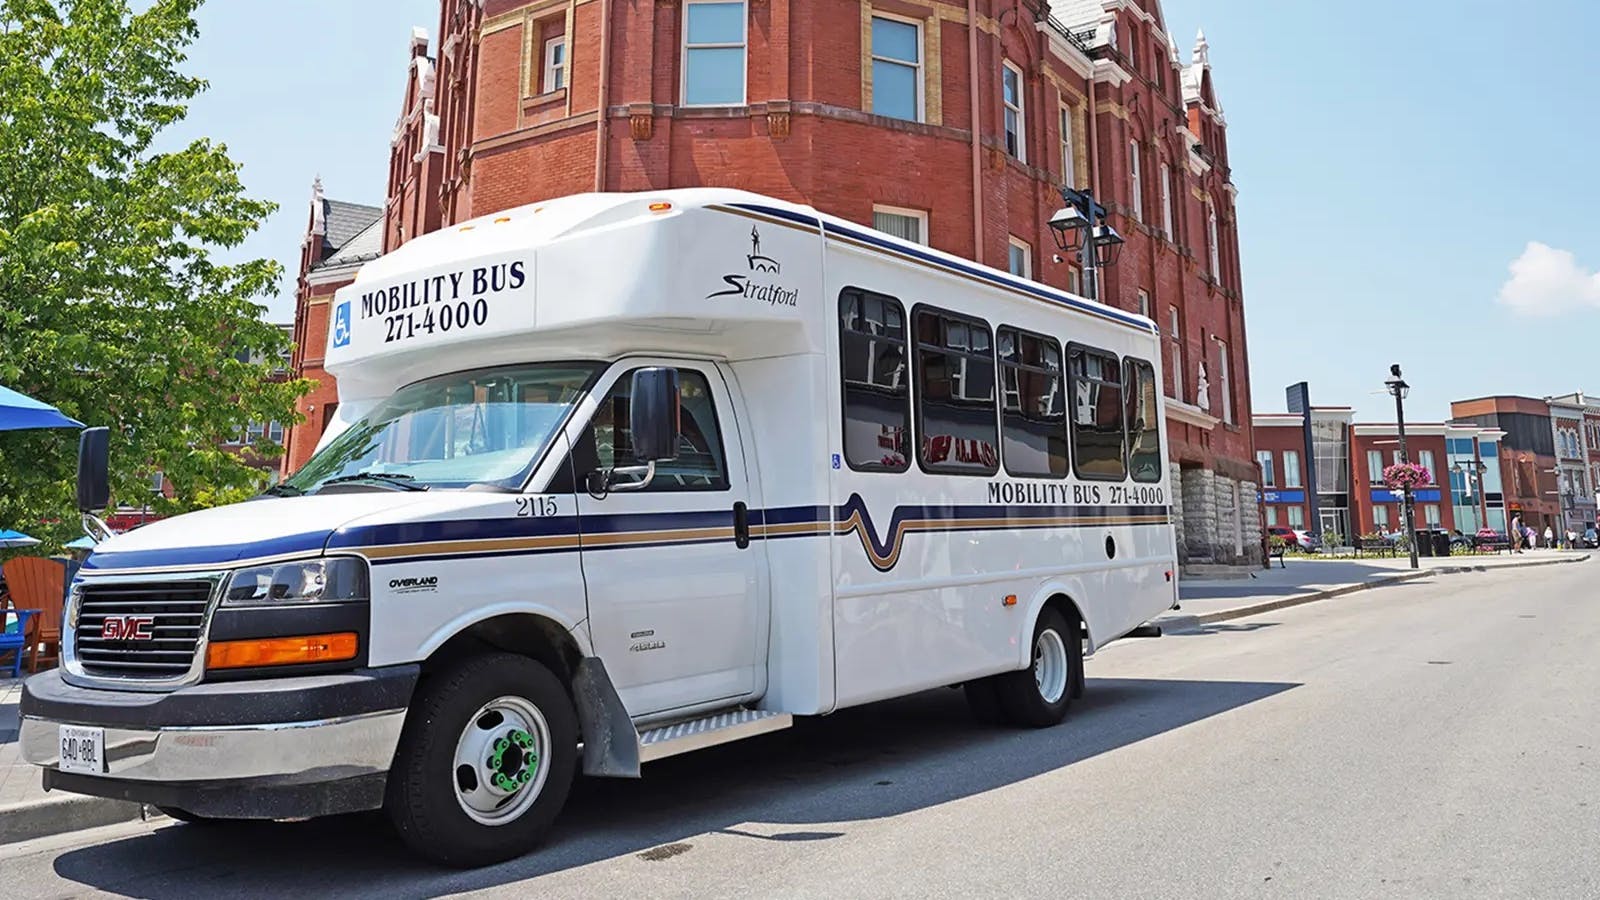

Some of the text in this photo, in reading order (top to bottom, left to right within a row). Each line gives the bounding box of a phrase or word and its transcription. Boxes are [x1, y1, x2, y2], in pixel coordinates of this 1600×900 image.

[361, 261, 526, 319] MOBILITY BUS
[705, 274, 799, 306] Stratford
[384, 298, 488, 343] 271-4000
[988, 482, 1164, 504] MOBILITY BUS 271-4000
[515, 495, 558, 517] 2115
[389, 576, 438, 588] OVERLAND
[102, 616, 154, 640] GMC
